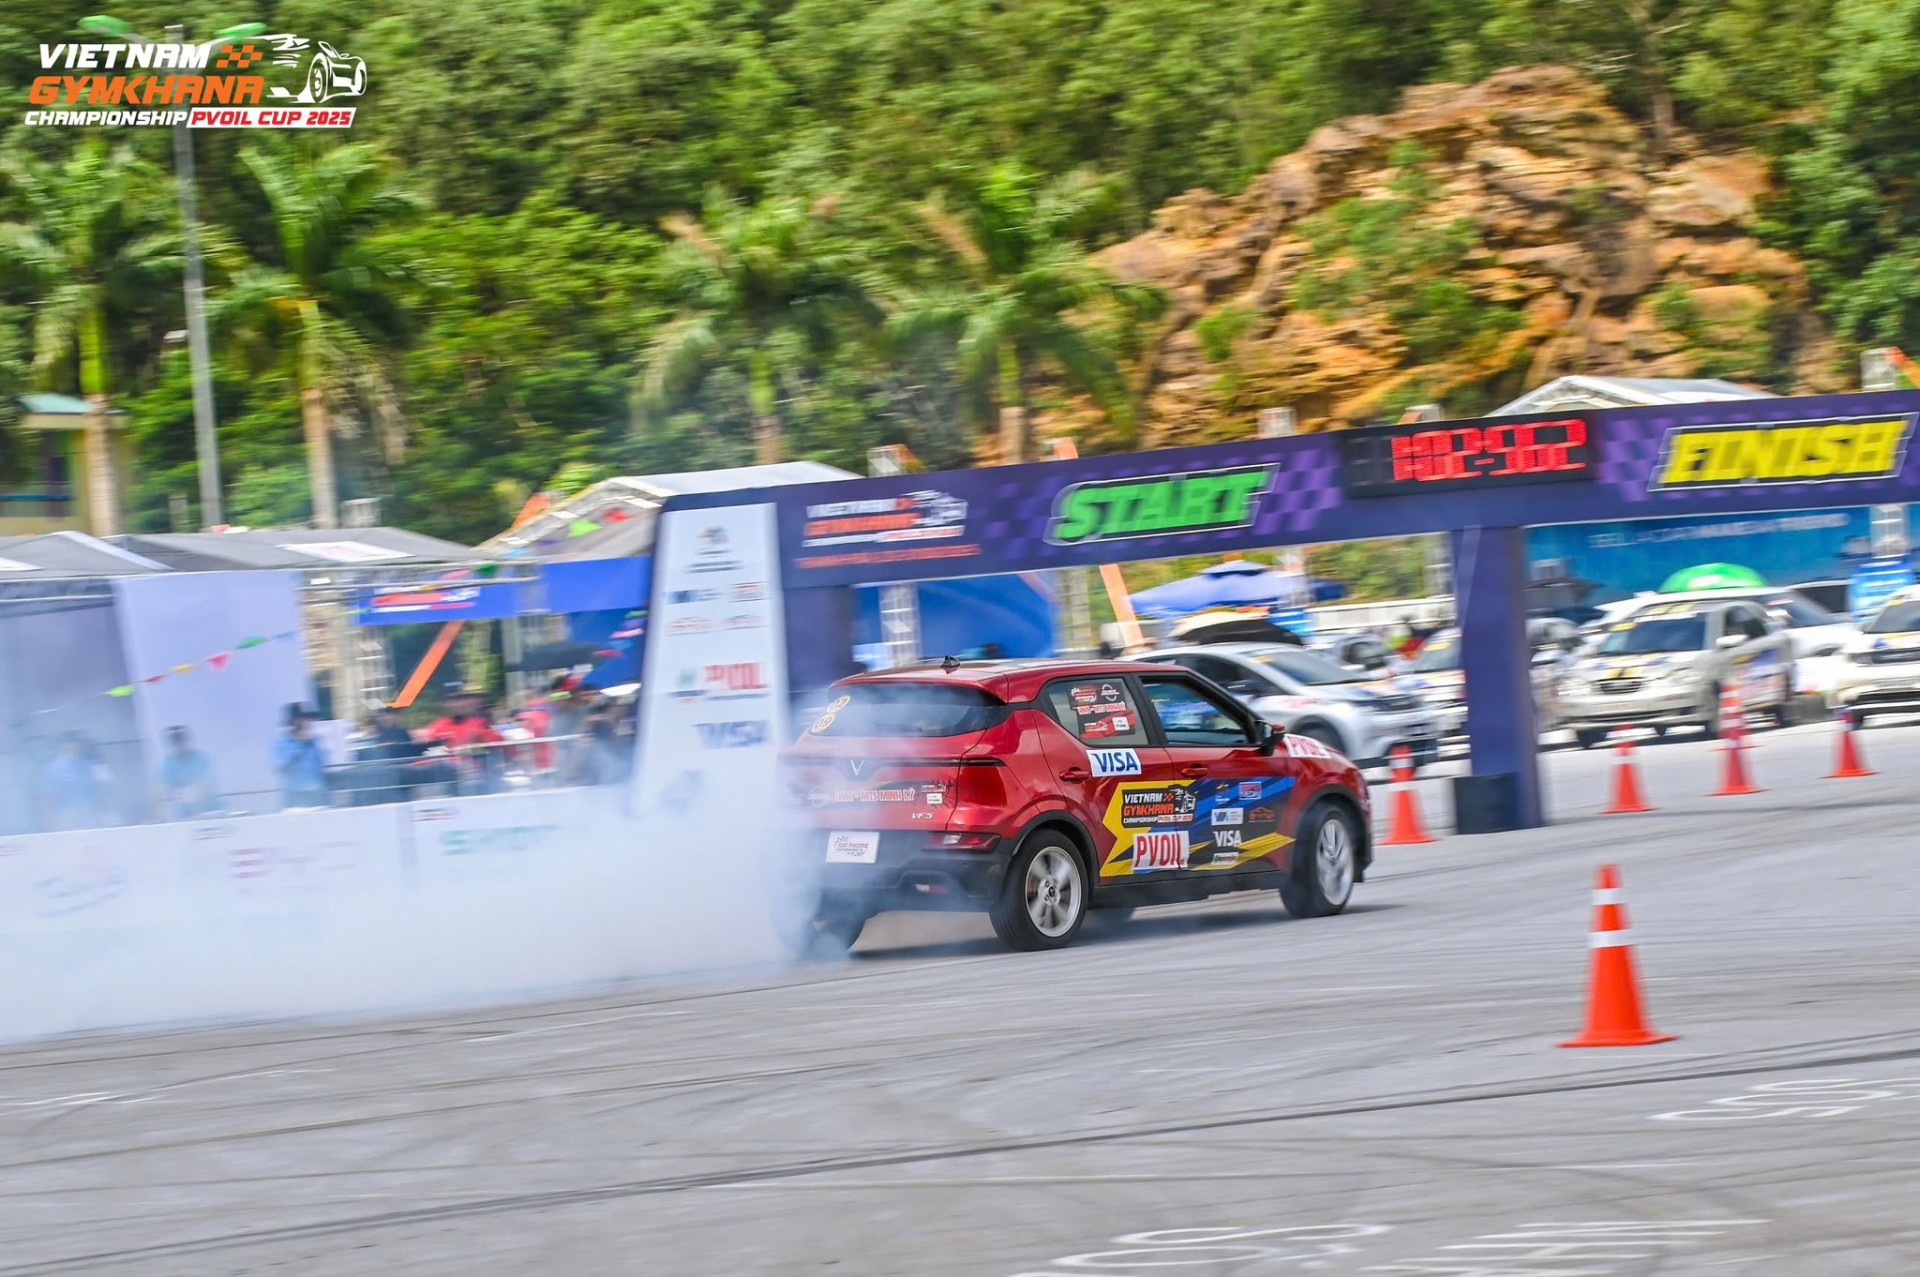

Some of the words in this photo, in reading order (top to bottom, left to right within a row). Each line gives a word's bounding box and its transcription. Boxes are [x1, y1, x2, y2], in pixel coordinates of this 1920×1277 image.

[1658, 420, 1910, 484] FINISH
[1055, 469, 1270, 540] START
[1091, 751, 1138, 773] VISA
[1124, 793, 1163, 804] VIETNAM
[1123, 804, 1175, 816] GYMKHANA
[1212, 830, 1243, 848] VISA
[1134, 834, 1185, 867] PVOIL
